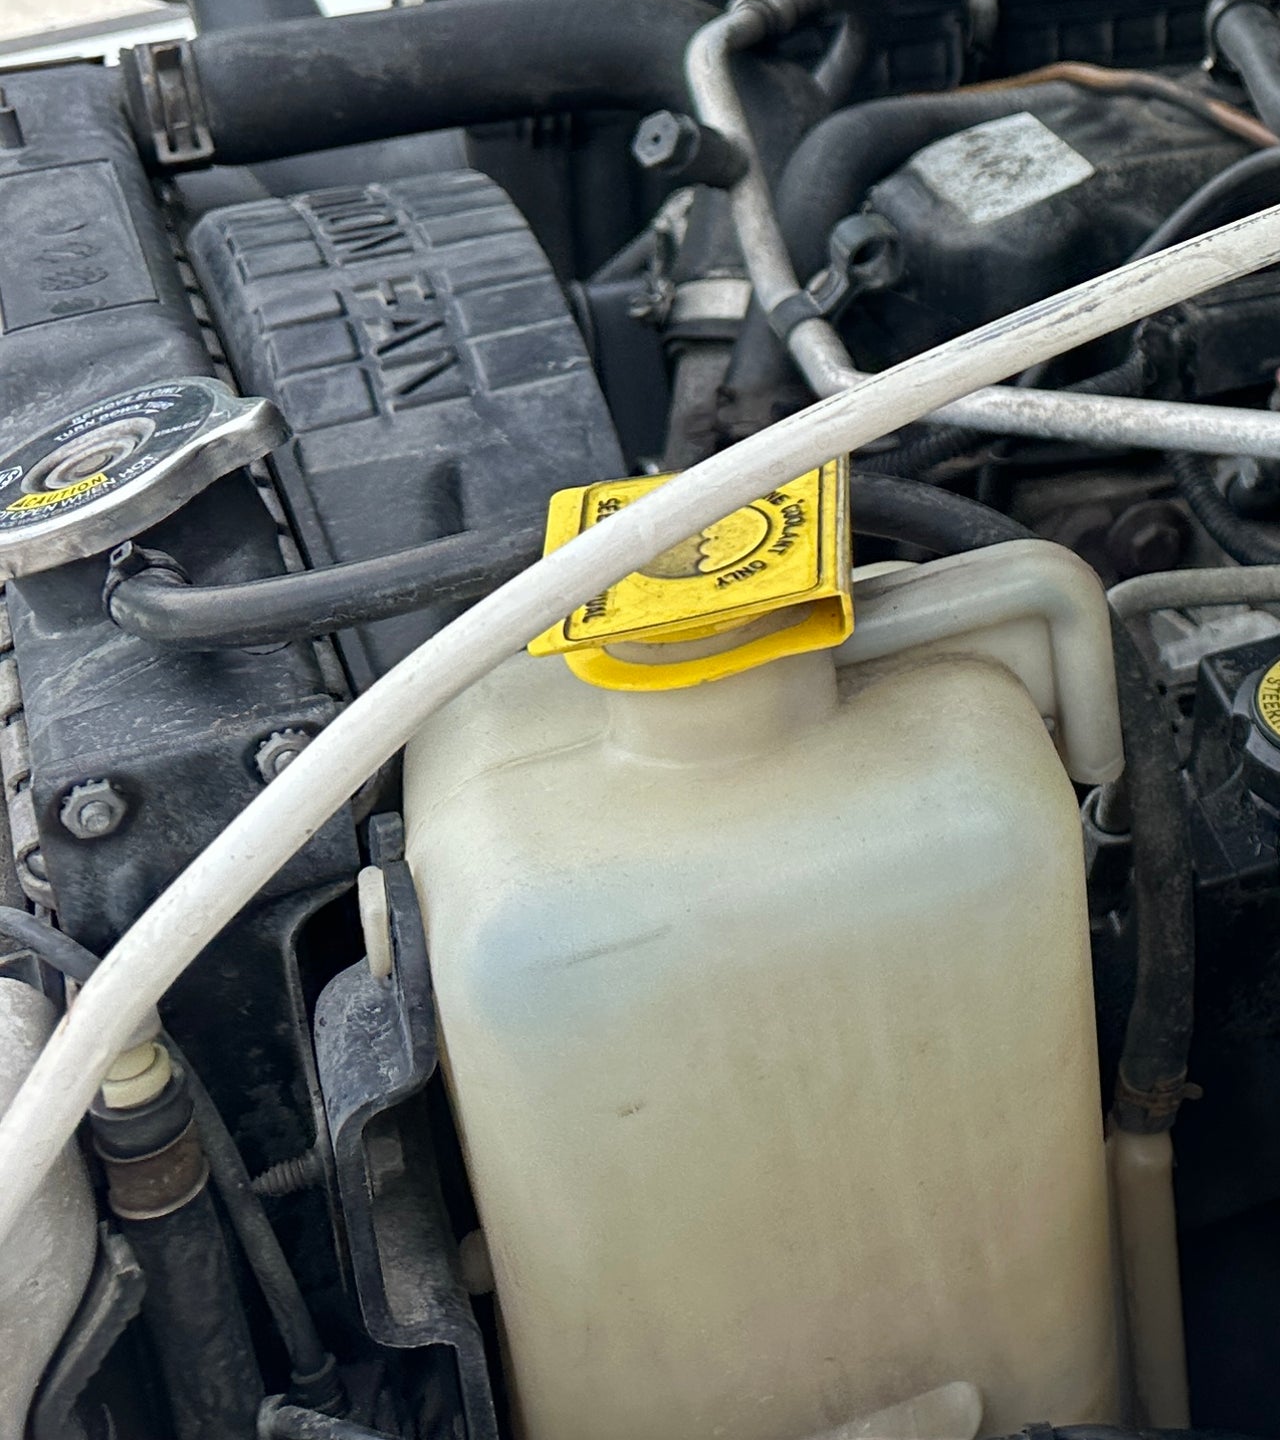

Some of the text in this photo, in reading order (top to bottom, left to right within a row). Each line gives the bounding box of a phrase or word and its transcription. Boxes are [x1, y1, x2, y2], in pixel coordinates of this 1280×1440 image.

[119, 454, 155, 479] HOT
[24, 475, 103, 508] CAUTION
[715, 560, 768, 589] ONLY
